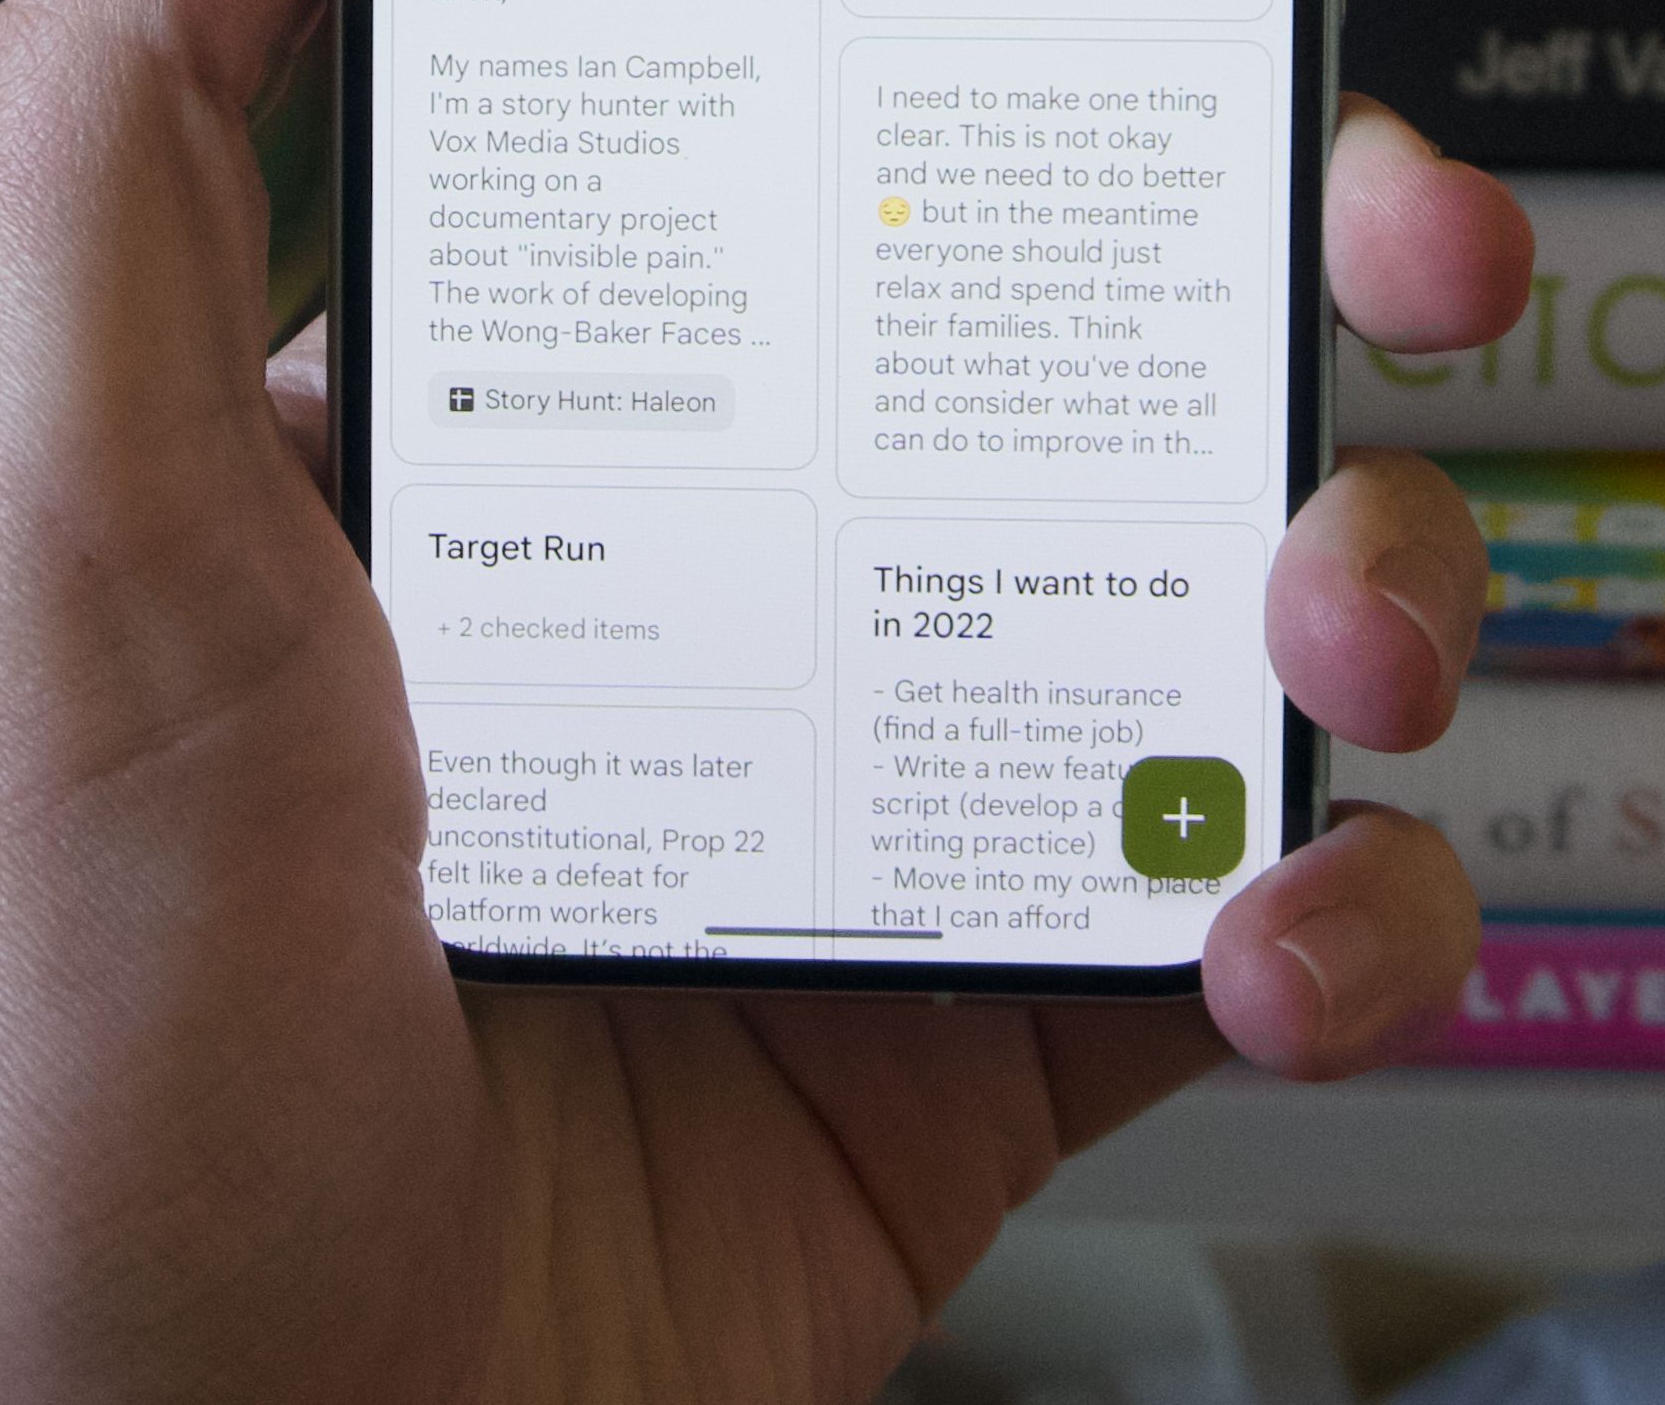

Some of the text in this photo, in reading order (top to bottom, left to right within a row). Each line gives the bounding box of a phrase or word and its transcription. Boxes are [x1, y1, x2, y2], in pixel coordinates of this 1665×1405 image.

[430, 53, 761, 86] My names Ian Campbell,
[1461, 30, 1585, 98] Jeff
[428, 128, 681, 156] Vox Media Studios
[876, 121, 1173, 157] clear. This is not okay
[428, 203, 718, 238] documentary project
[428, 241, 724, 275] about "invisible pain."
[875, 236, 1162, 271] everyone should just
[874, 311, 1143, 340] their families. Think
[485, 387, 716, 417] Story Hunt: Haleon
[427, 532, 606, 569] Target Run
[873, 564, 1190, 603] Things I want to do
[873, 608, 994, 640] in 2022
[872, 713, 1144, 750] (find a full-time job)
[427, 748, 754, 783] Even though it was later
[1486, 785, 1583, 859] of
[870, 827, 1096, 860] writing practice)
[427, 858, 690, 889] felt like a defeat for
